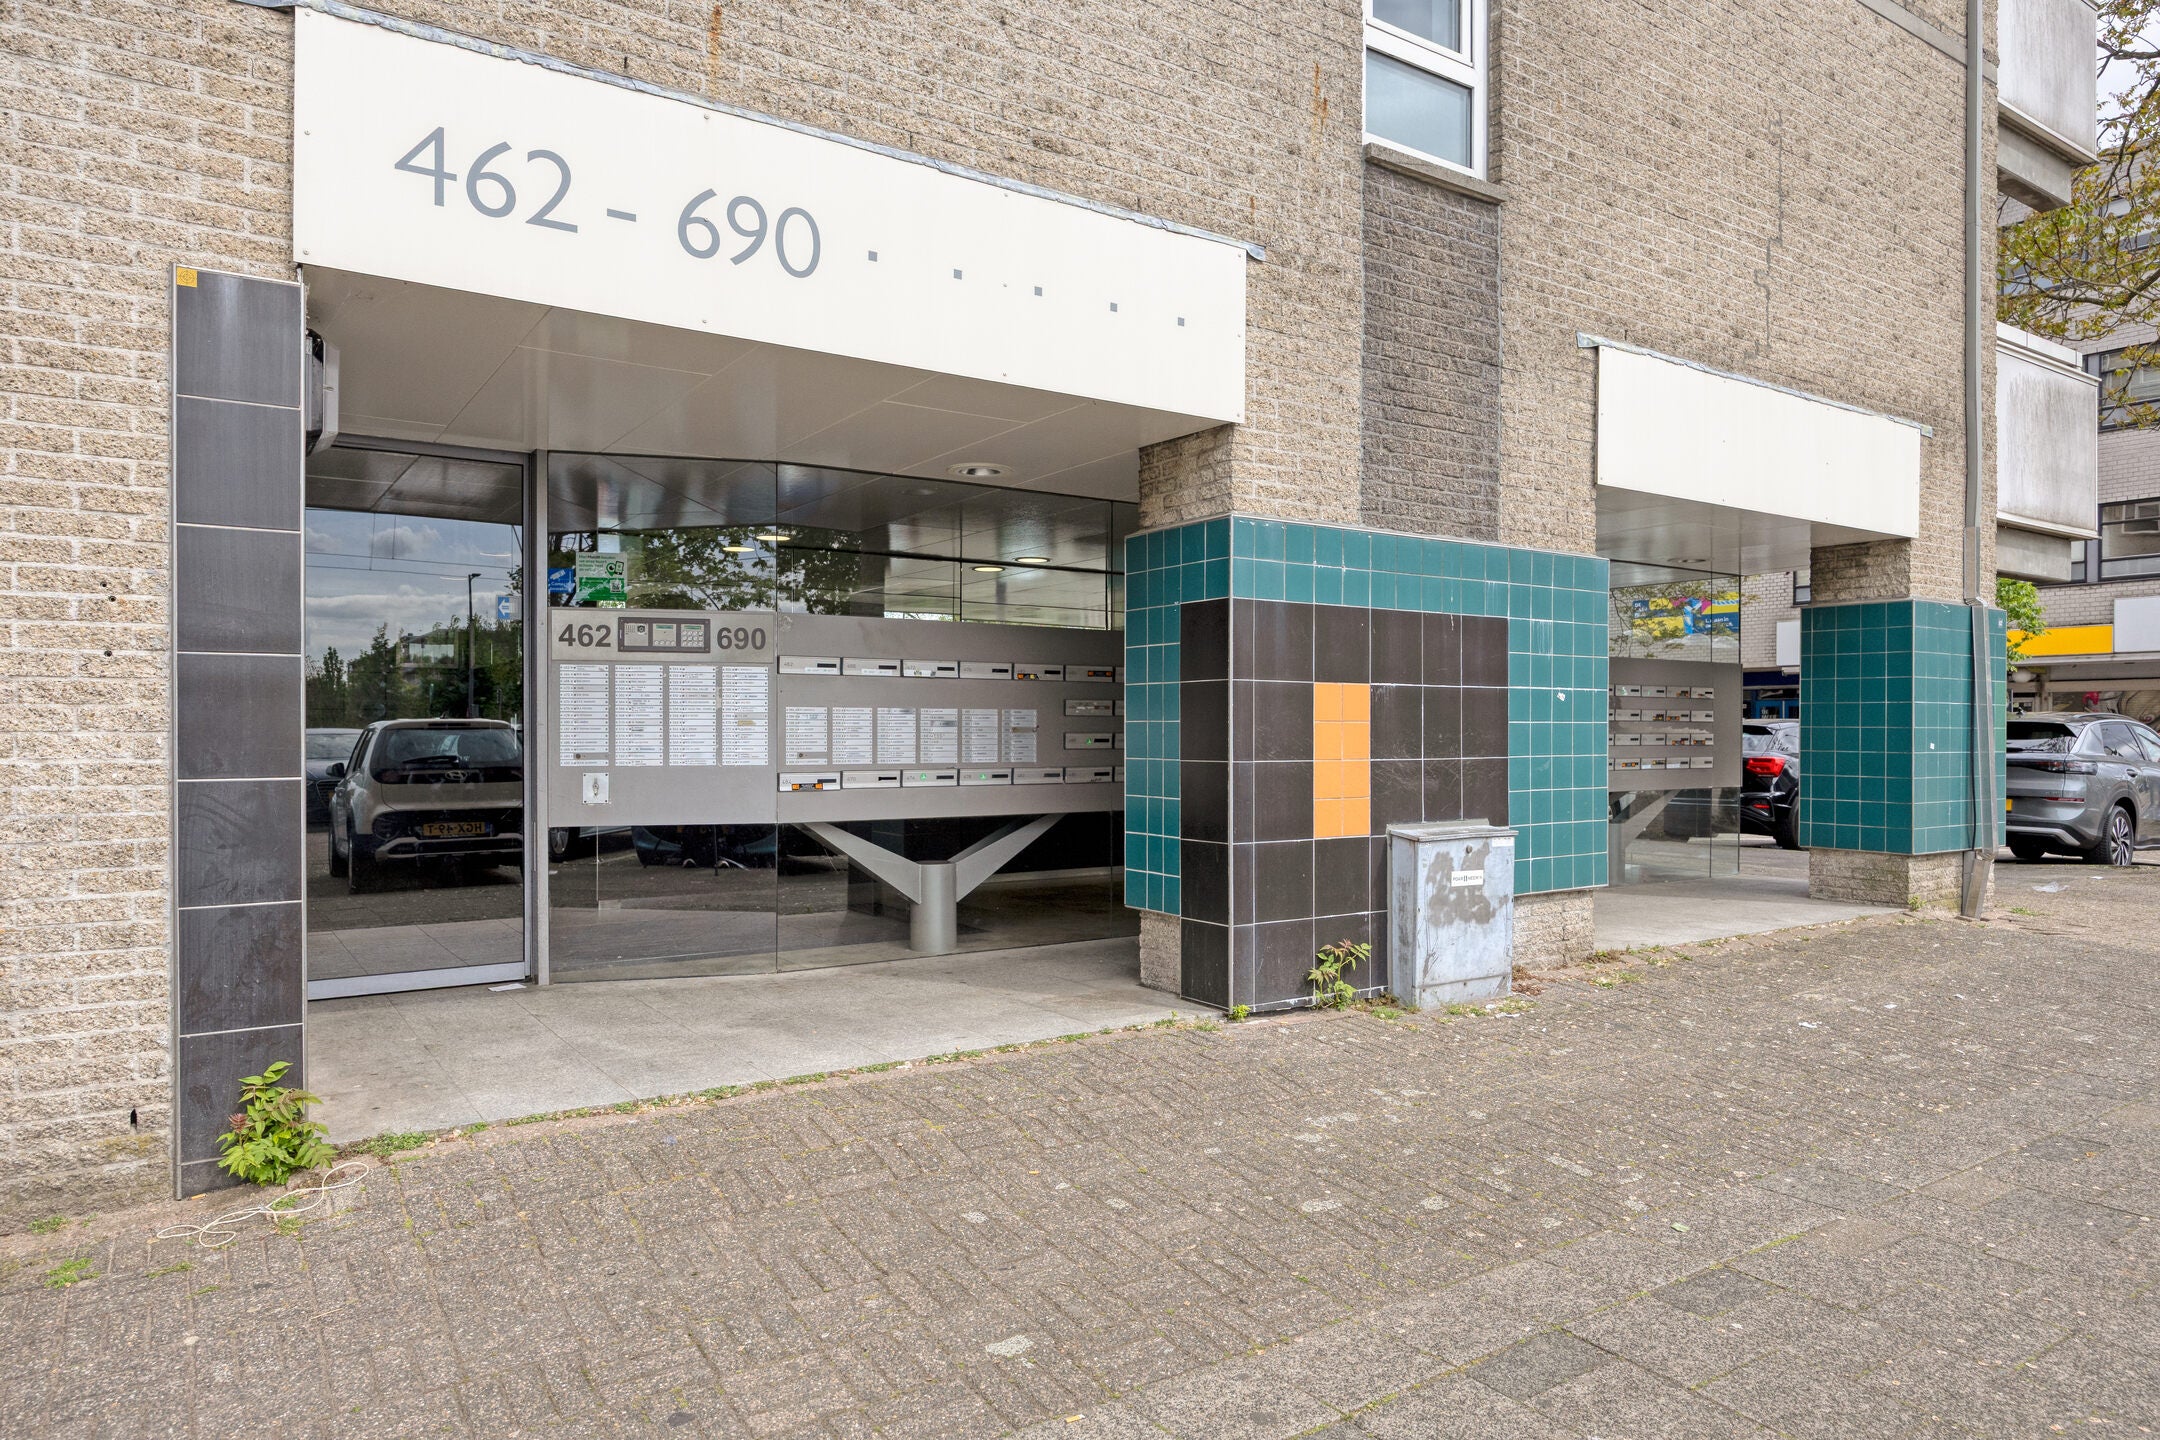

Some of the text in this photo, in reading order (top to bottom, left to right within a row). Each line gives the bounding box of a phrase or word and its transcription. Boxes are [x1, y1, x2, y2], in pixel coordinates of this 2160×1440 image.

[395, 127, 820, 278] 462 - 690
[558, 623, 766, 650] 462 690
